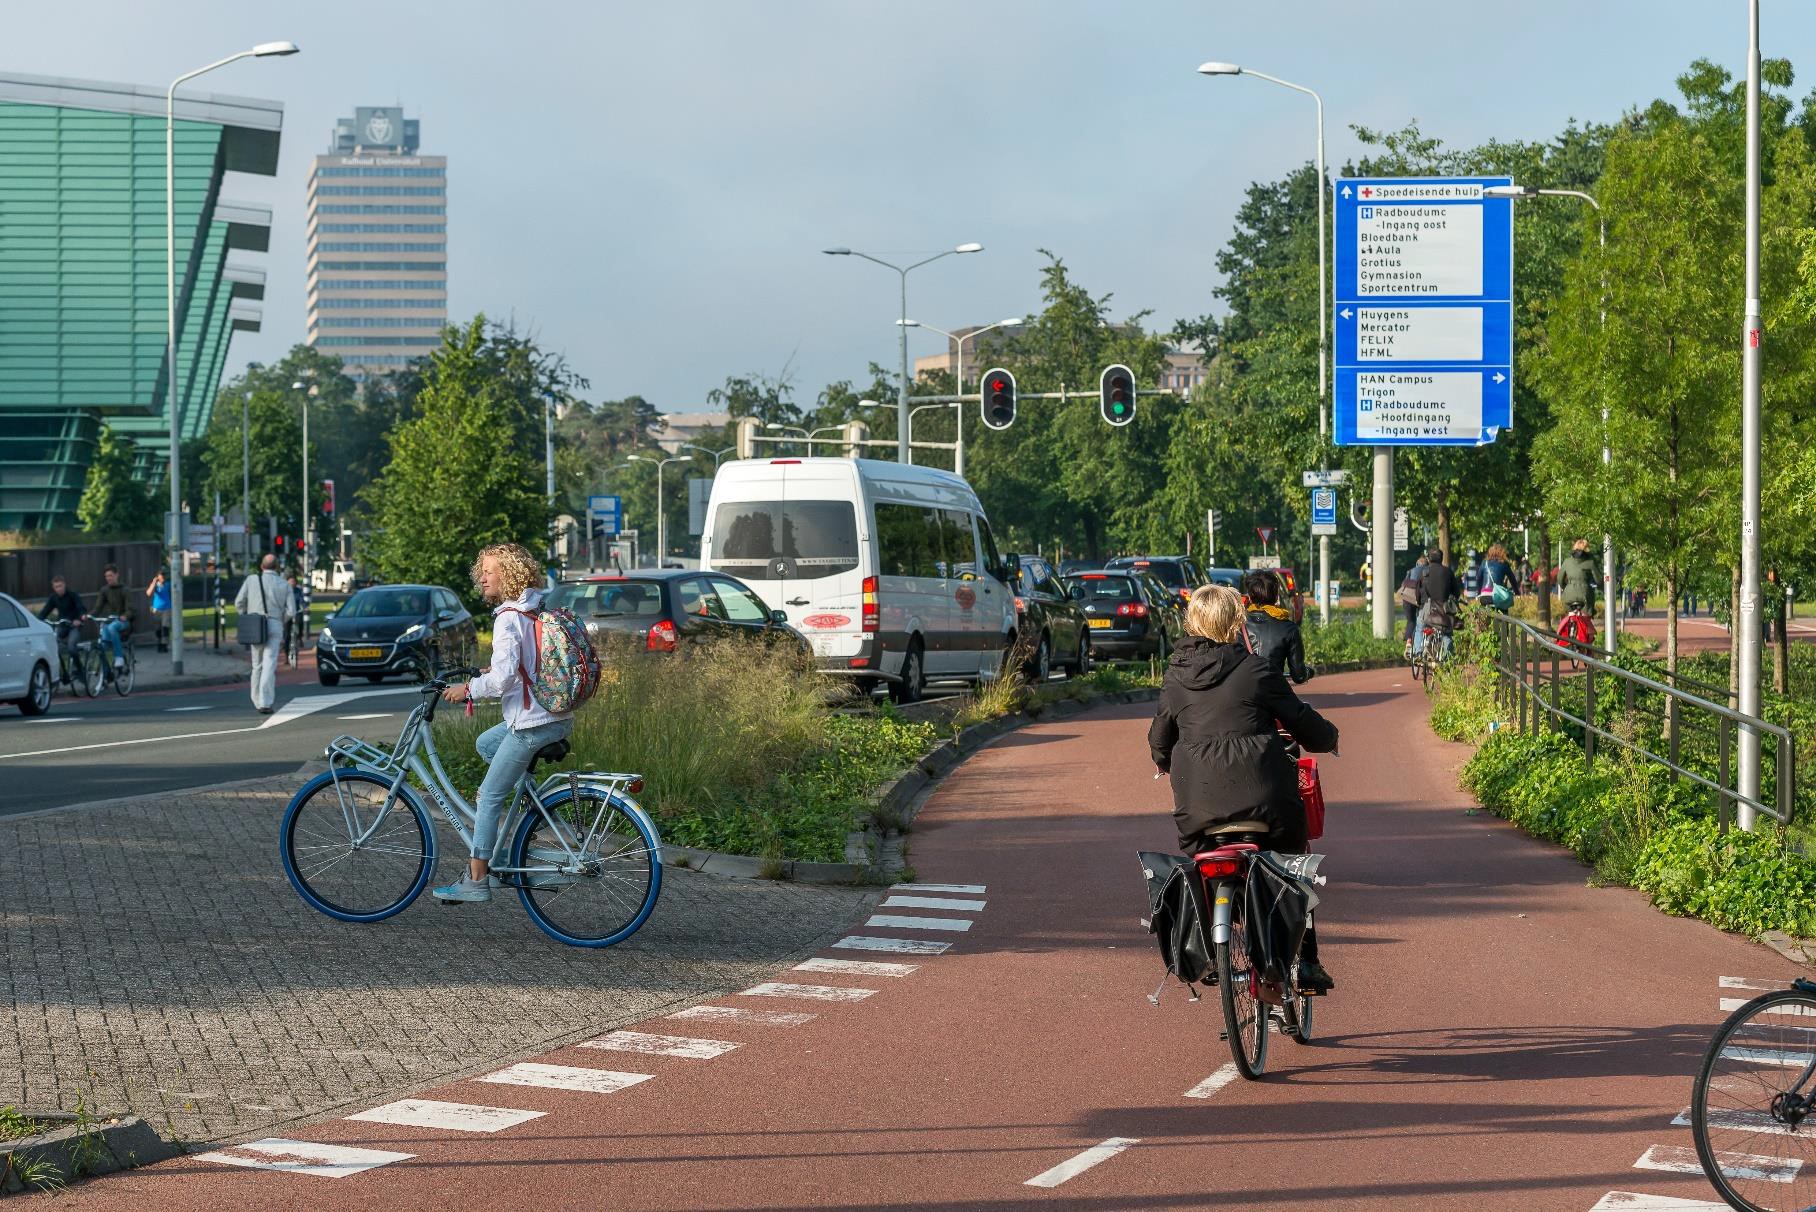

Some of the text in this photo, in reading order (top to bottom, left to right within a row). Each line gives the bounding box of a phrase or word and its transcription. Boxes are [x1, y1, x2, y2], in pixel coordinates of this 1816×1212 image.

[1377, 187, 1479, 198] Spoedeisende hulp
[1376, 208, 1446, 216] Radboudumc
[1362, 233, 1417, 242] Bloedbank
[1376, 246, 1400, 254] Aula
[1361, 258, 1401, 267] Grotius
[1361, 271, 1421, 281] Gymnasion
[1362, 284, 1437, 293] Sportcentrum
[1362, 311, 1408, 321] Huygens
[1361, 323, 1410, 332] Mercator
[1361, 336, 1393, 344] FELIX
[1361, 348, 1392, 357] HFML
[1361, 375, 1432, 385] HAN Campus
[1361, 388, 1394, 399] Trigon
[1376, 400, 1445, 409] Radboudumc
[1423, 426, 1448, 435] west
